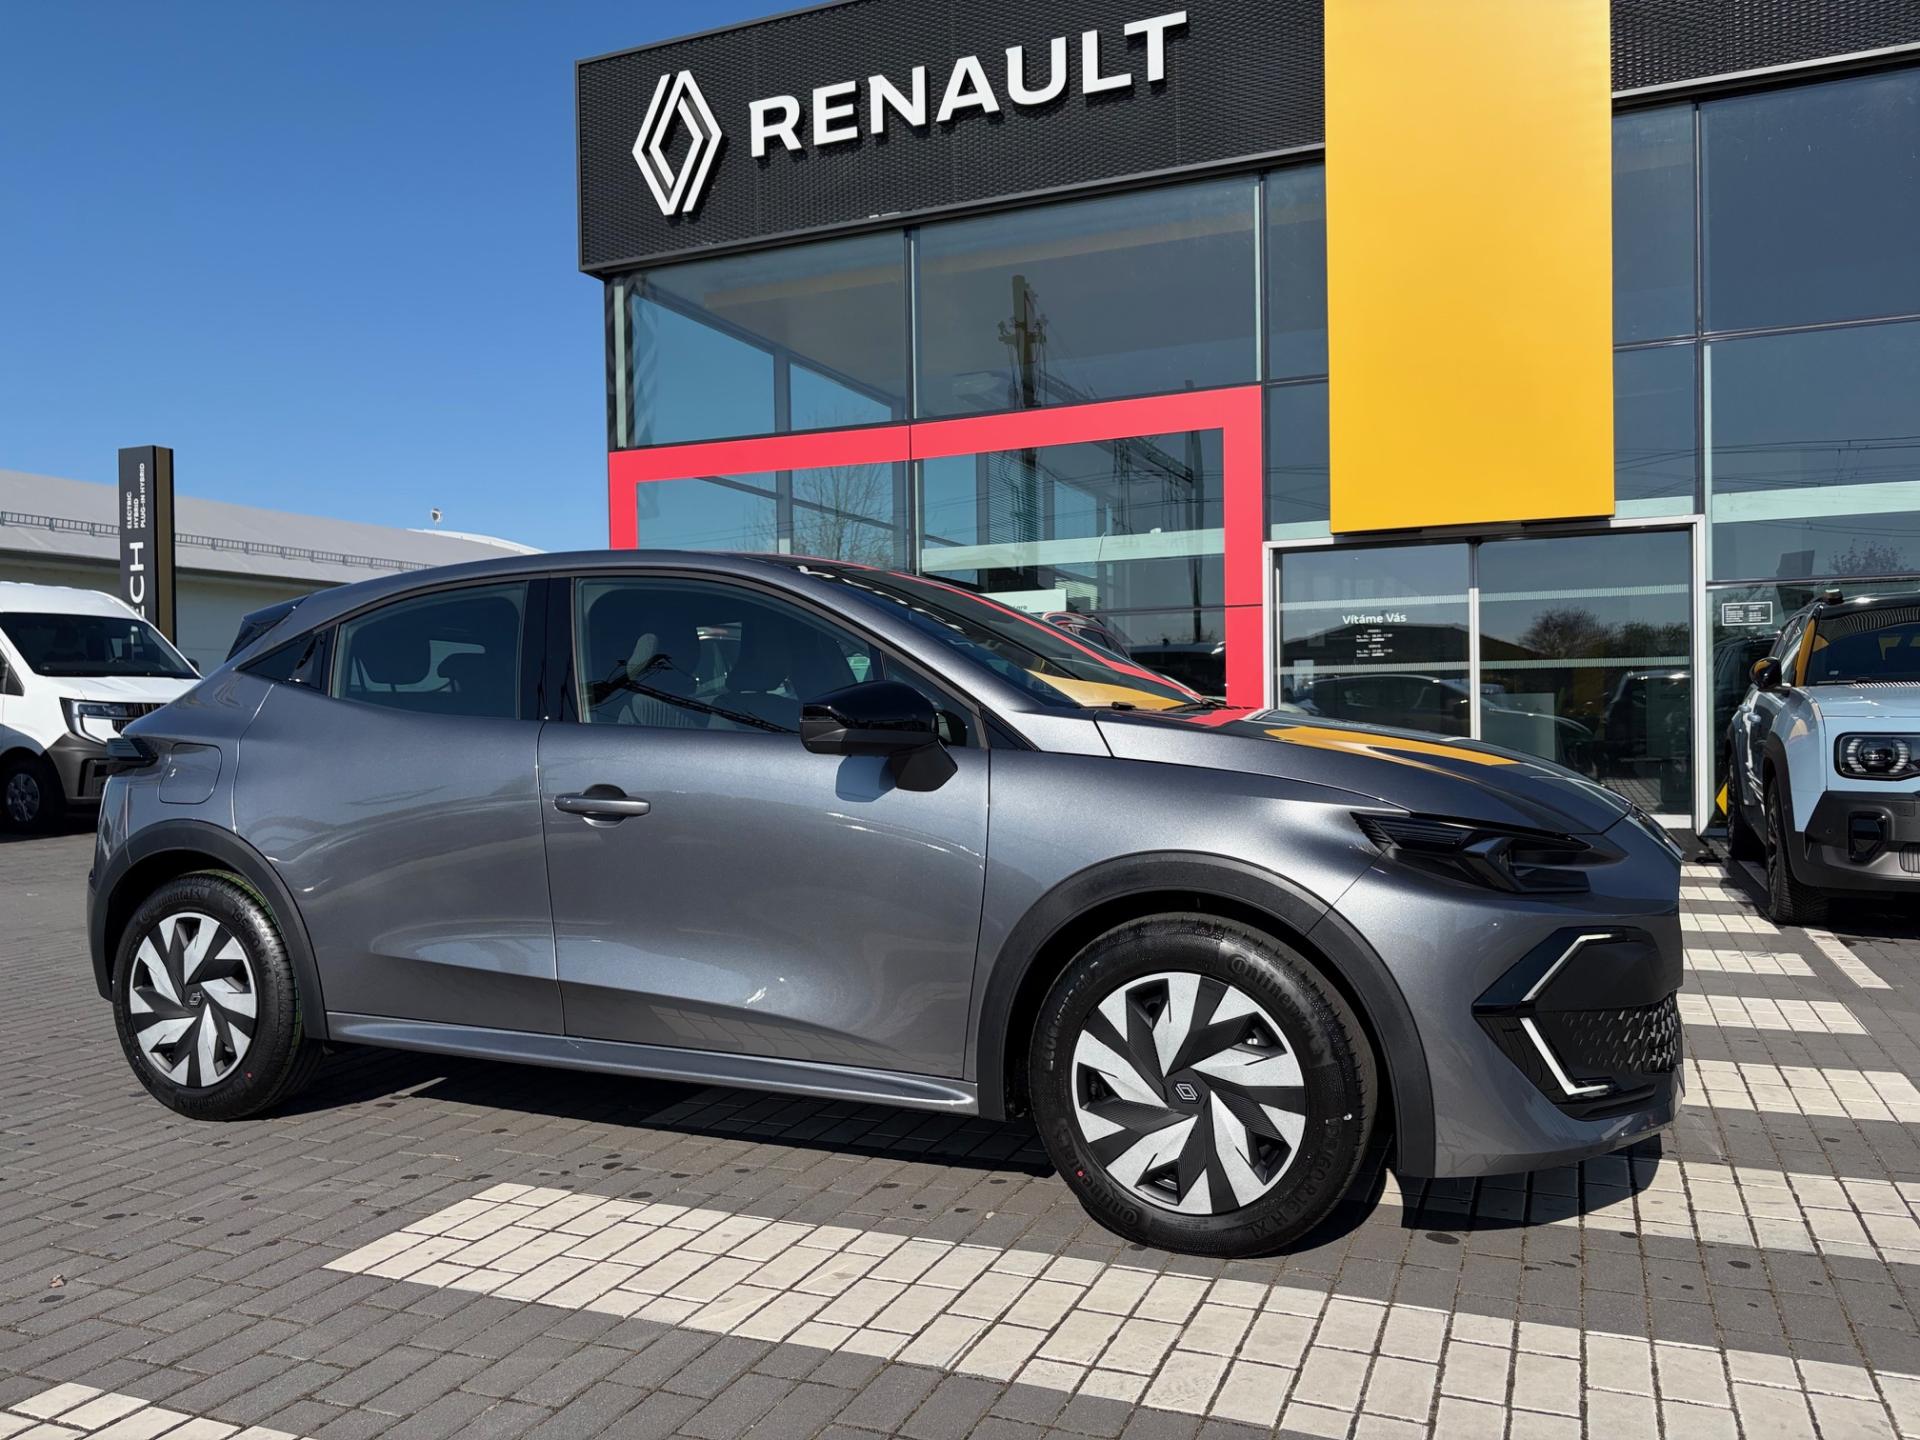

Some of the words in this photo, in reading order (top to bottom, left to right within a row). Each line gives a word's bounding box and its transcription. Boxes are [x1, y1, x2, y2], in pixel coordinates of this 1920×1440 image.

[749, 10, 1188, 158] RENAULT
[1342, 614, 1384, 625] Vítáme
[1385, 612, 1407, 623] Vás
